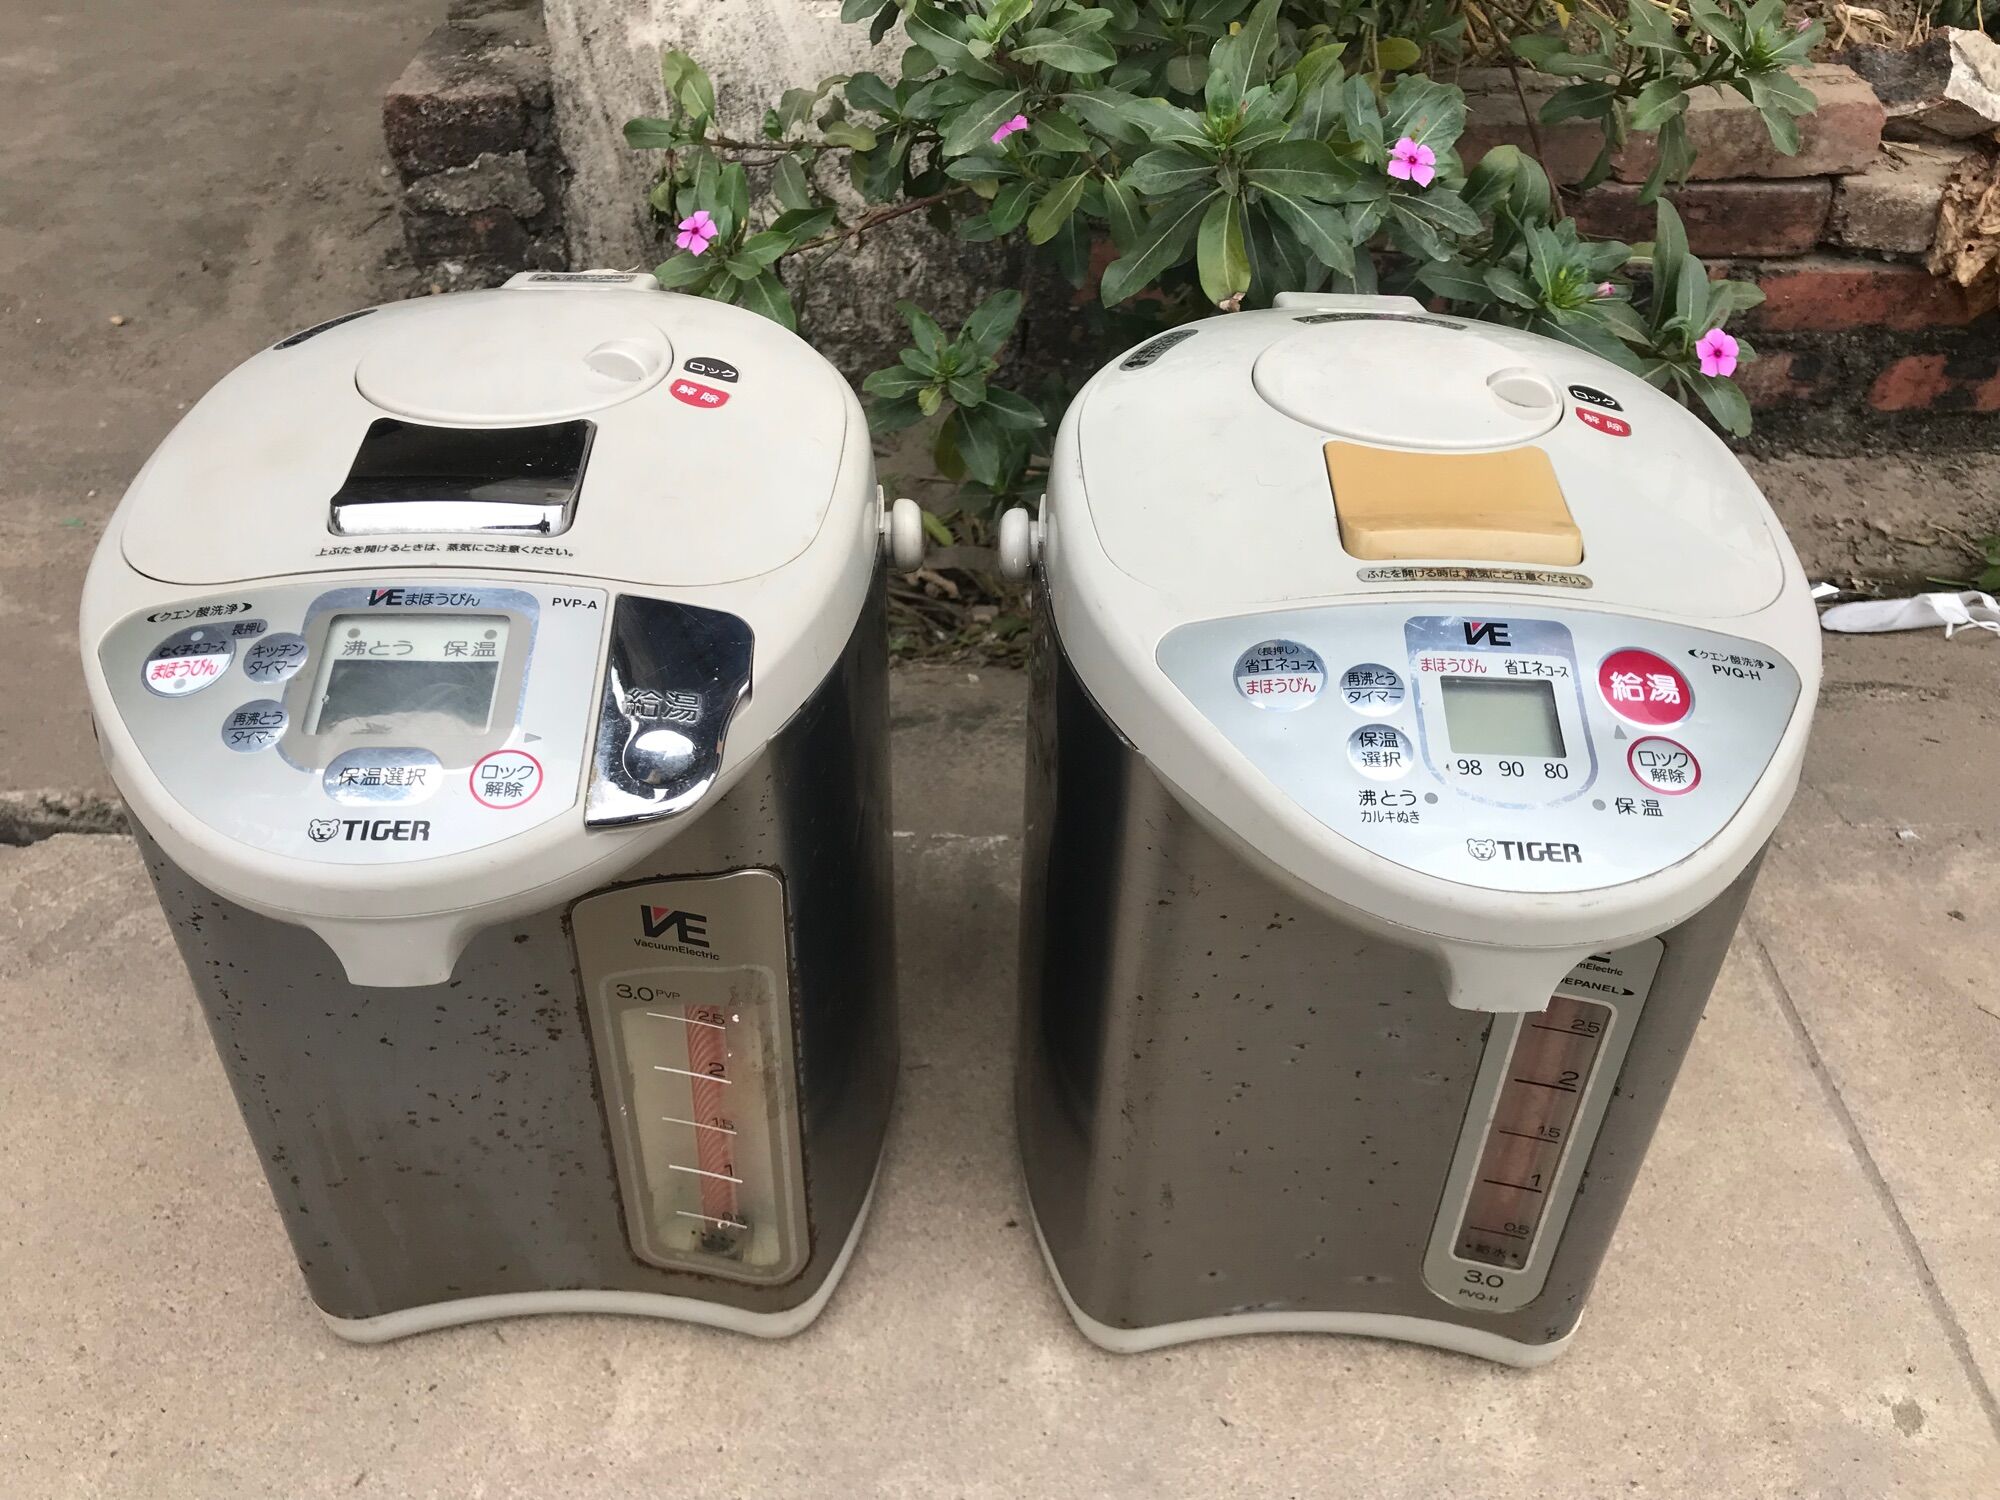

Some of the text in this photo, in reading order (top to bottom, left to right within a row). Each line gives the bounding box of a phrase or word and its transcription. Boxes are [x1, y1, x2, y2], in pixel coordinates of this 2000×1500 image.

[690, 361, 737, 378] ロック
[676, 384, 720, 404] 解除
[1573, 390, 1616, 406] ロック
[404, 592, 480, 607] まほうびん
[552, 597, 598, 610] PVP-A
[160, 603, 238, 622] クエン酸洗浄
[231, 622, 266, 636] 長押し
[1463, 621, 1512, 647] VE
[252, 643, 305, 658] キッチン
[342, 639, 496, 657] 沸とう 保温
[249, 660, 299, 676] タイマー
[1244, 657, 1318, 673] 省エネコース
[1420, 657, 1570, 678] まほうびん 省エネコース
[1699, 649, 1765, 669] クエン酸洗浄
[151, 658, 219, 681] まほうびん
[1347, 671, 1397, 686] 再沸とう
[1712, 664, 1762, 681] PVQ-H
[1246, 677, 1317, 695] まほうびん
[1609, 671, 1681, 705] 給湯
[1347, 689, 1402, 704] タイマー
[621, 689, 700, 723] 給湯
[232, 709, 284, 728] 再沸とう
[230, 729, 276, 745] タイマー
[1358, 731, 1399, 748] 保温
[1361, 751, 1402, 768] 選択
[1637, 749, 1689, 768] ロック
[338, 767, 427, 787] 保温選択
[480, 763, 534, 780] ロック
[1456, 758, 1569, 780] 98 90 80
[1649, 767, 1688, 784] 解除
[483, 780, 523, 798] 解除
[1358, 789, 1417, 807] 沸とう
[1614, 796, 1664, 817] 保温
[1360, 810, 1420, 824] カルキぬき
[342, 819, 431, 842] TIGER
[1497, 840, 1582, 863] TIGER
[640, 904, 710, 948] VE
[633, 938, 720, 961] VacuumElectric
[616, 983, 681, 1002] 3.0 PVP
[1571, 1019, 1601, 1033] 2.5
[708, 1062, 726, 1078] 2
[1558, 1070, 1580, 1087] 2
[1531, 1173, 1542, 1188] 1
[1464, 1269, 1504, 1289] 3.0
